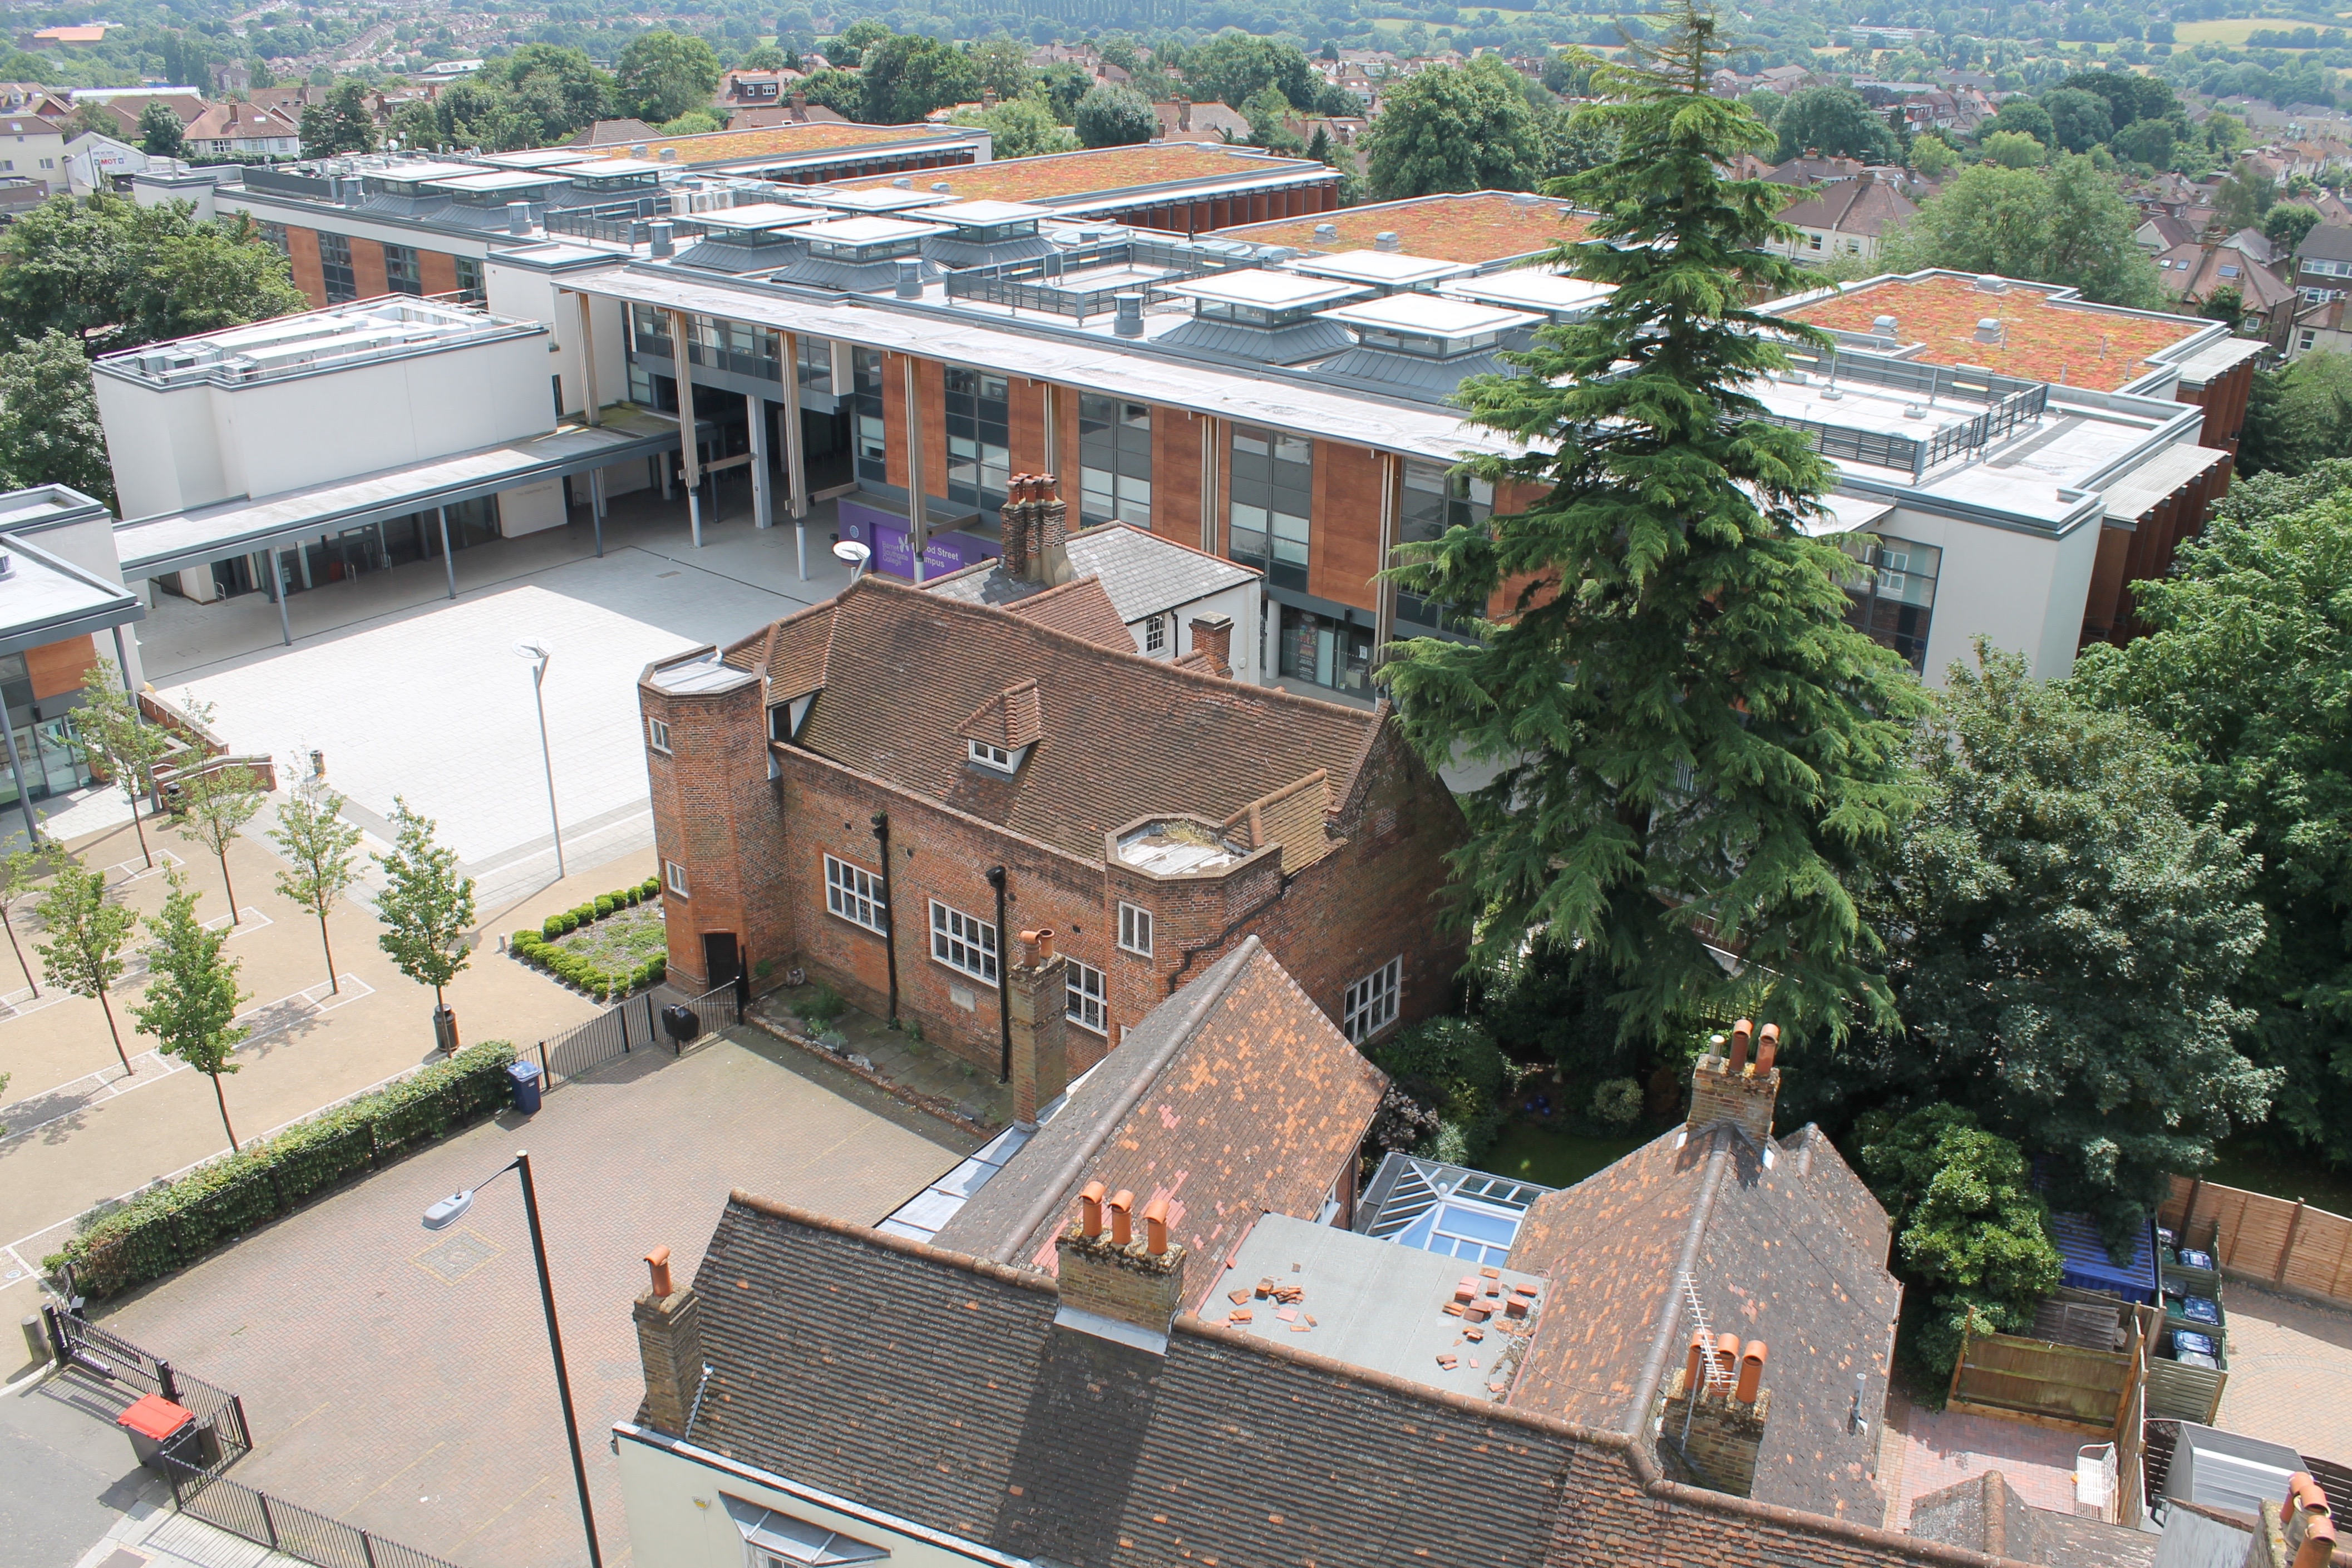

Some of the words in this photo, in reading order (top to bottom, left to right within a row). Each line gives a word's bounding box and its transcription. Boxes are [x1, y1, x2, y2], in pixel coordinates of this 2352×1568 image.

[882, 541, 899, 551] Barnet
[882, 549, 908, 561] Southgate
[882, 554, 901, 566] College
[938, 548, 959, 561] Street
[924, 557, 945, 568] mpus
